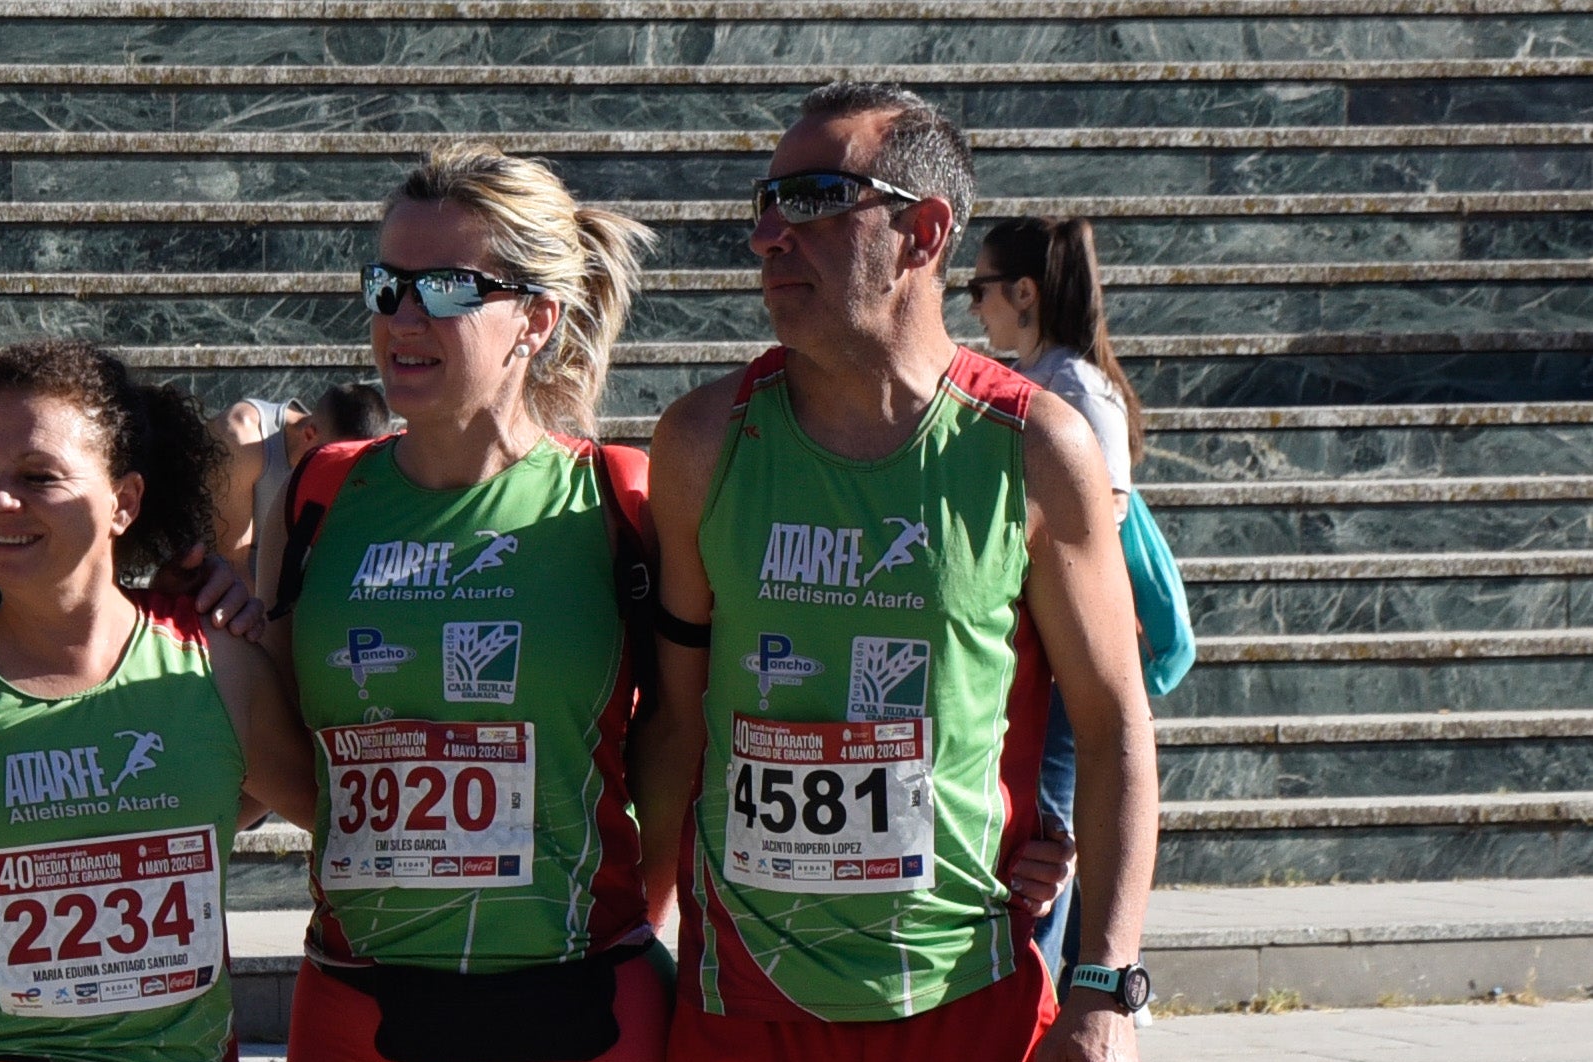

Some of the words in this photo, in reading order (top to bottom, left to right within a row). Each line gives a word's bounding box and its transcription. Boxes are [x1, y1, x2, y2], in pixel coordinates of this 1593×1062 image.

[351, 541, 455, 586] ATARFE
[760, 523, 863, 587] ATARFE
[348, 586, 445, 601] Atletismo
[452, 586, 515, 600] Atarfe
[758, 582, 857, 606] Atletismo
[862, 591, 925, 609] Atarfe
[348, 628, 405, 664] Poncho
[760, 634, 812, 672] Poncho
[447, 683, 473, 692] CAJA
[478, 683, 513, 694] RURAL
[851, 704, 878, 713] CAJA
[883, 706, 922, 717] RURAL
[335, 730, 360, 761] 40
[443, 743, 449, 757] 4
[452, 744, 476, 758] MAYO
[479, 745, 502, 758] 2024
[735, 719, 749, 754] 40
[749, 731, 773, 747] MEDIA
[775, 732, 823, 749] MARATÓN
[783, 749, 823, 760] GRANADA
[840, 746, 846, 760] 4
[849, 746, 874, 759] MAYO
[877, 744, 902, 758] 2024
[6, 746, 109, 808] ATARFE
[10, 801, 110, 825] Atletismo
[117, 793, 180, 813] Atarfe
[338, 766, 496, 834] 3920
[734, 763, 888, 835] 4581
[414, 839, 447, 851] GARCIA
[794, 842, 830, 854] ROPERO
[833, 842, 862, 854] LOPEZ
[0, 856, 34, 890] 40
[34, 860, 68, 876] MEDIA
[71, 852, 120, 870] MARATÓN
[36, 874, 67, 888] CIUDAD
[70, 872, 80, 884] DE
[82, 868, 122, 882] GRANADA
[138, 863, 144, 876] 4
[146, 859, 170, 874] MAYO
[171, 856, 193, 871] 2024
[4, 881, 194, 966] 2234
[32, 970, 62, 982] MARIA
[65, 966, 99, 979] EDUINA
[101, 961, 146, 976] SANTIAGO
[148, 953, 188, 969] SANTIAGO
